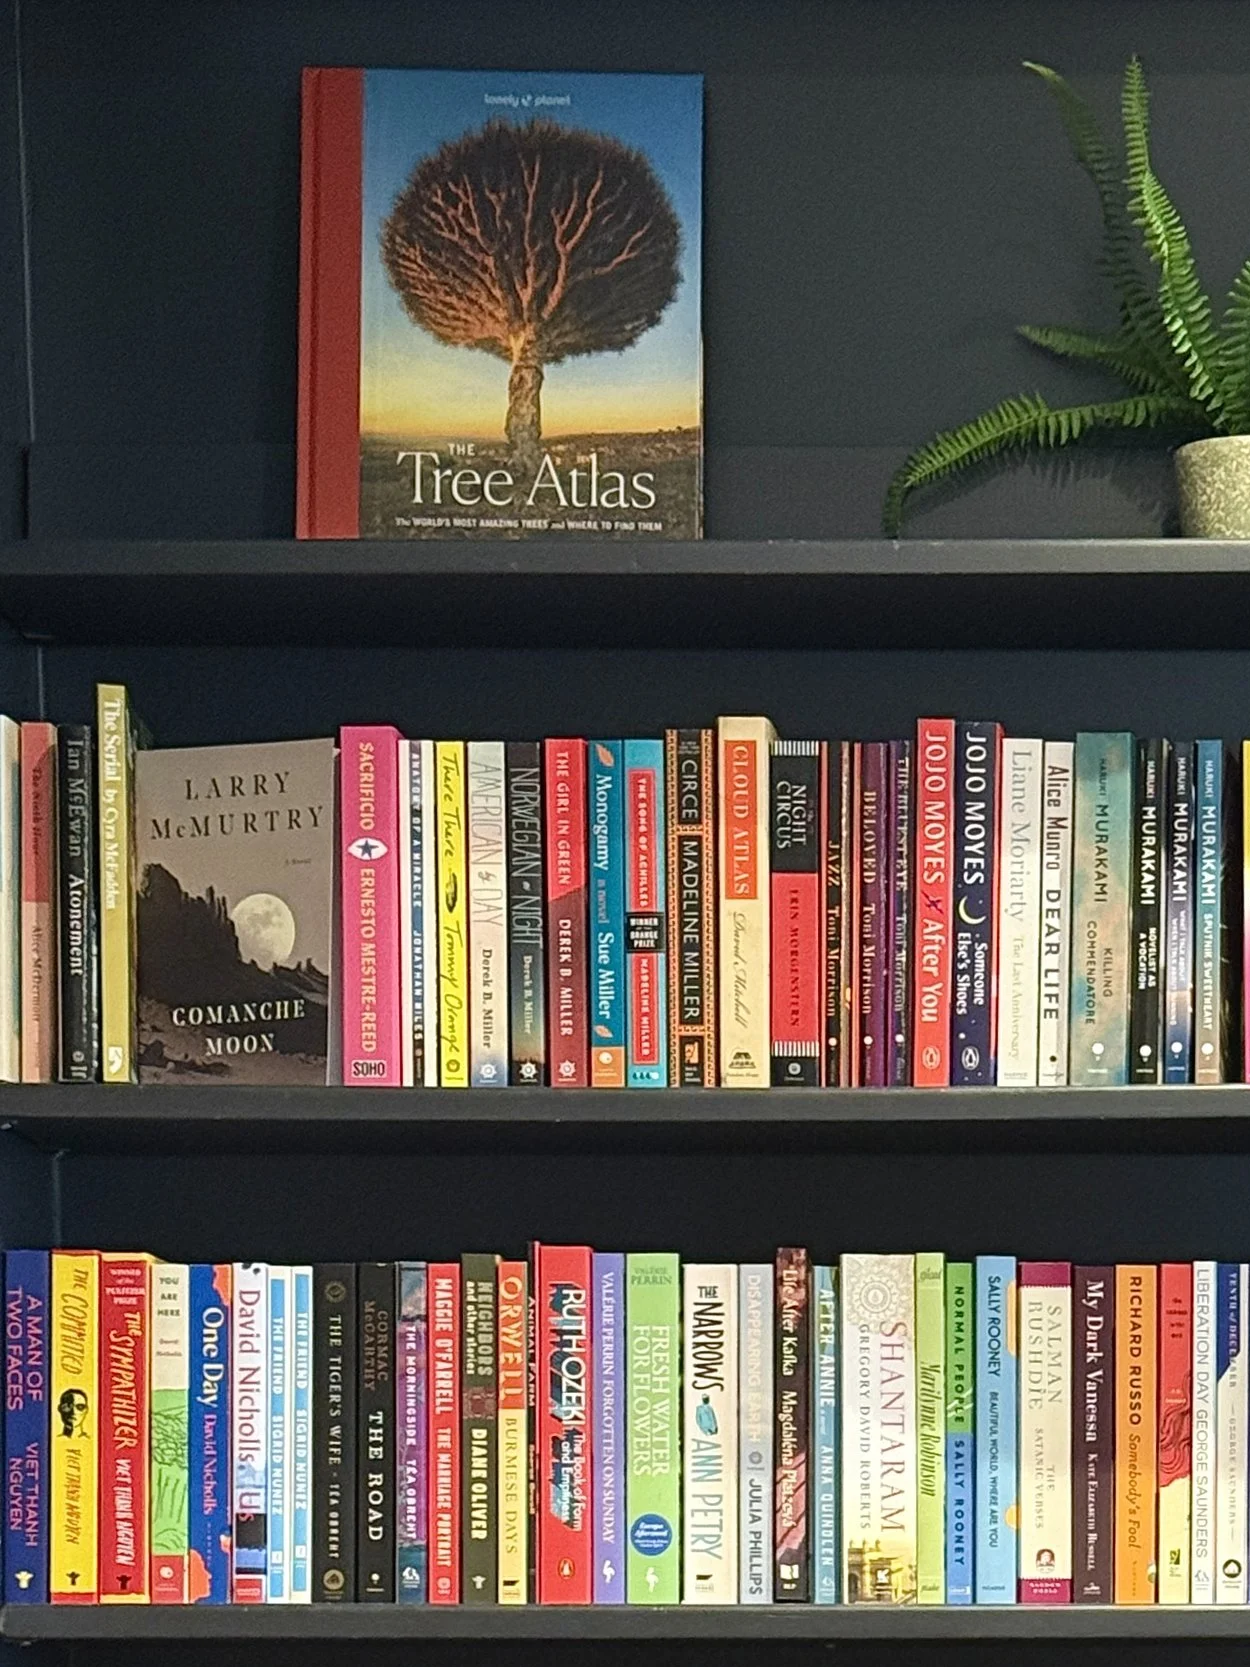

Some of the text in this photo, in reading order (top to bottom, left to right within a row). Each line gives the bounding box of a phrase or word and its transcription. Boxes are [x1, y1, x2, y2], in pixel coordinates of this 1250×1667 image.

[484, 94, 571, 107] lonely planet
[396, 449, 656, 508] Tree Atlas
[448, 443, 475, 455] THE
[412, 517, 450, 527] WORLD'S
[453, 518, 476, 527] MOST
[479, 518, 518, 528] AMAZING
[521, 519, 548, 529] TREES
[551, 521, 565, 529] and
[567, 521, 598, 530] WHERE
[601, 522, 611, 530] TO
[614, 522, 635, 530] FIND
[638, 522, 662, 531] THEM
[103, 700, 121, 909] The Serial by Cyra McFadden
[151, 806, 324, 839] McMURTRY
[185, 772, 290, 799] LARRY
[1094, 758, 1107, 902] HARUKI MURAKAMI
[67, 740, 85, 976] Ian McEwan Atonement
[359, 742, 376, 1052] SACRIFICIO ERNESTO MESTRE-REED
[557, 752, 573, 1035] THE GIRL IN GREEN DEREK B. MILLER
[681, 760, 699, 1019] CIRCE MADELINE MILLER
[732, 746, 749, 1028] CLOUD ATLAS David Mitchell
[922, 731, 946, 1022] JOJO MOYES After You
[173, 999, 305, 1026] COMANCHE
[1085, 921, 1097, 1024] COMMENDATORE
[1103, 948, 1112, 997] KILLING
[205, 1035, 274, 1055] MOON
[353, 1061, 385, 1076] SOHO
[7, 1288, 22, 1410] TWO FACES
[28, 1296, 42, 1400] A MAN OF
[198, 1307, 224, 1515] One Day David Nicholls
[880, 1321, 907, 1532] SHANTARAM
[955, 1286, 964, 1565] NORMAL PEOPLE SALLY ROONEY
[1126, 1276, 1141, 1548] RICHARD RUSSO Somebody's Fool
[10, 1458, 21, 1530] NGUYEN
[26, 1442, 38, 1546] VIET THANH
[368, 1412, 383, 1541] THE ROAD
